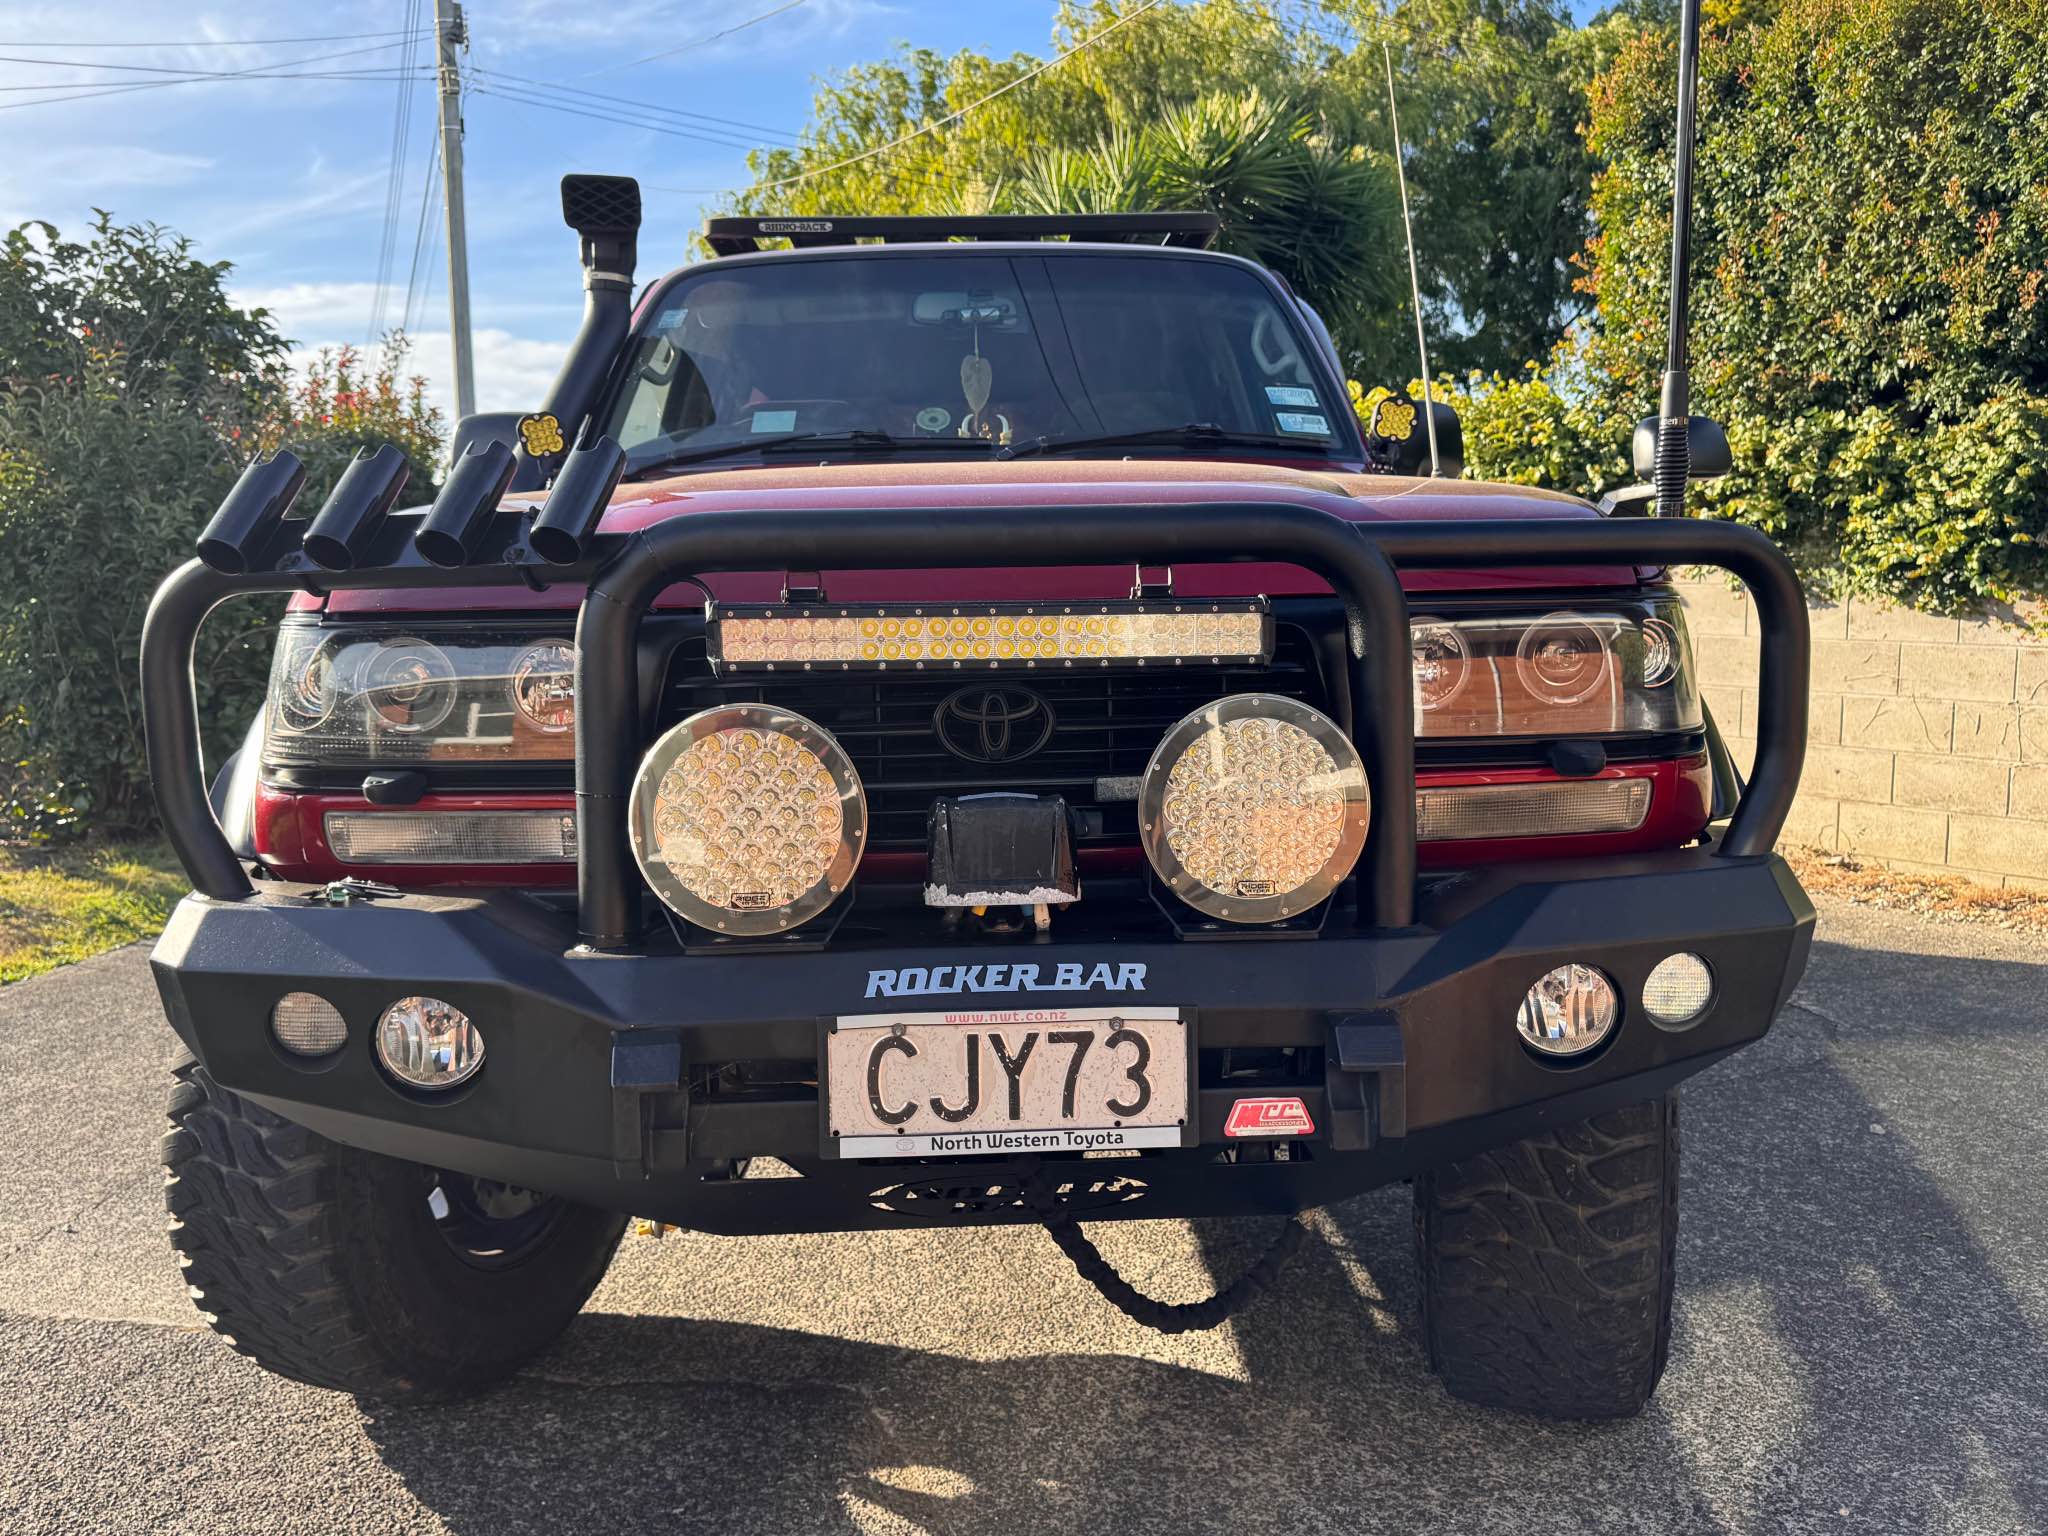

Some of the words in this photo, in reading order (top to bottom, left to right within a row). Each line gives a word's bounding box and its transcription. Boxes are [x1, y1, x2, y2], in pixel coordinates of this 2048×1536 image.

[864, 964, 1042, 998] ROCKER
[1055, 963, 1147, 991] BAR
[944, 1010, 1067, 1024] www.nwt.co.nz
[867, 1028, 1151, 1125] CJY73
[931, 1135, 982, 1151] North
[987, 1133, 1061, 1150] Western
[1064, 1131, 1124, 1150] Toyota
